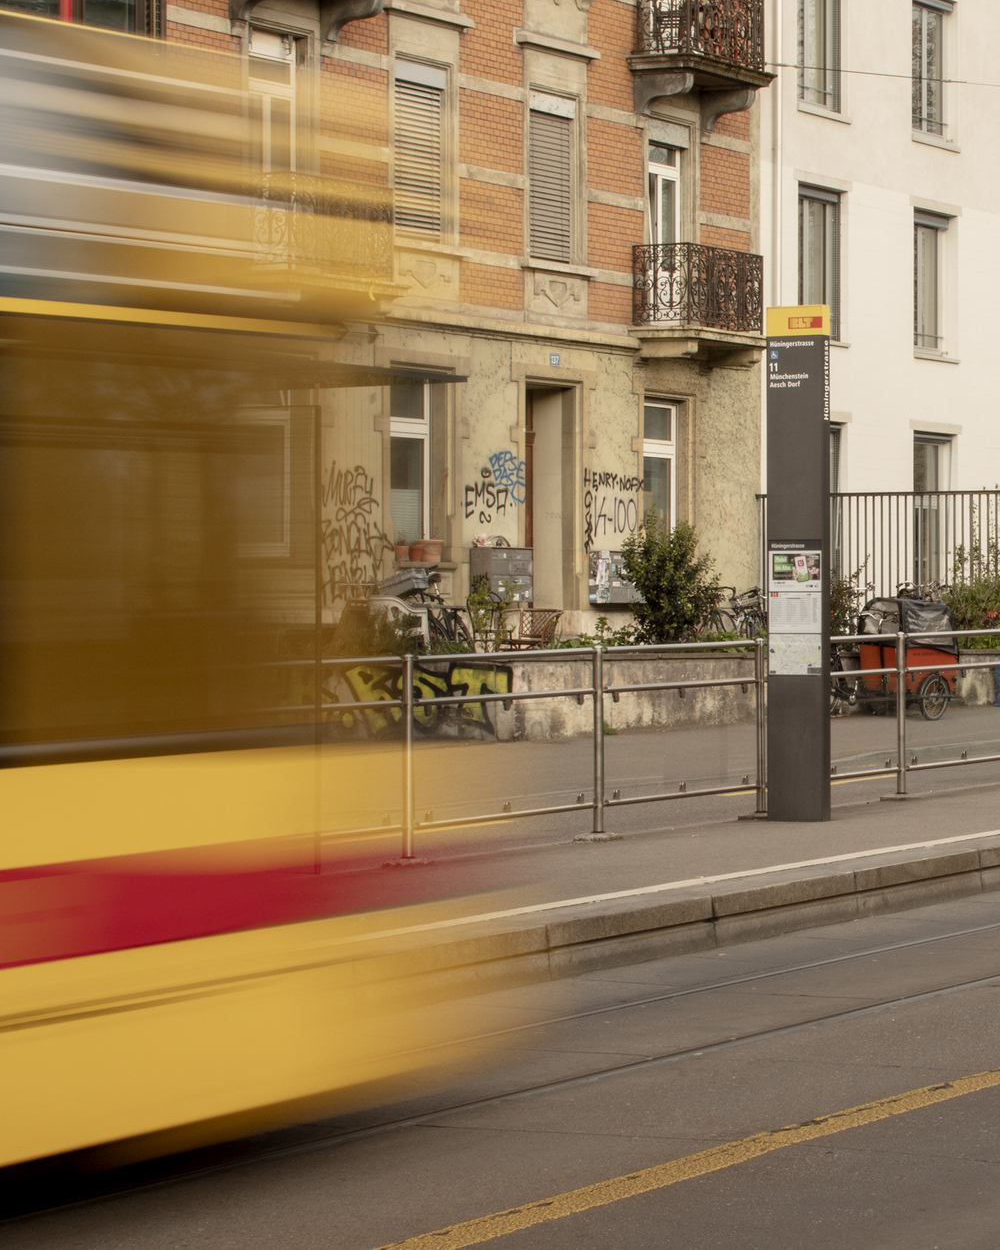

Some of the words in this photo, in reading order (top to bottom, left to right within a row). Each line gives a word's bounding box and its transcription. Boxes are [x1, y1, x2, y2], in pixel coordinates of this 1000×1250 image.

[789, 317, 814, 328] BLT
[769, 340, 815, 349] Hüningerstrasse
[550, 355, 560, 365] 137
[769, 362, 778, 372] 11
[769, 372, 809, 380] Münchenstein
[769, 381, 787, 389] Aesch
[584, 468, 617, 492] HENRY
